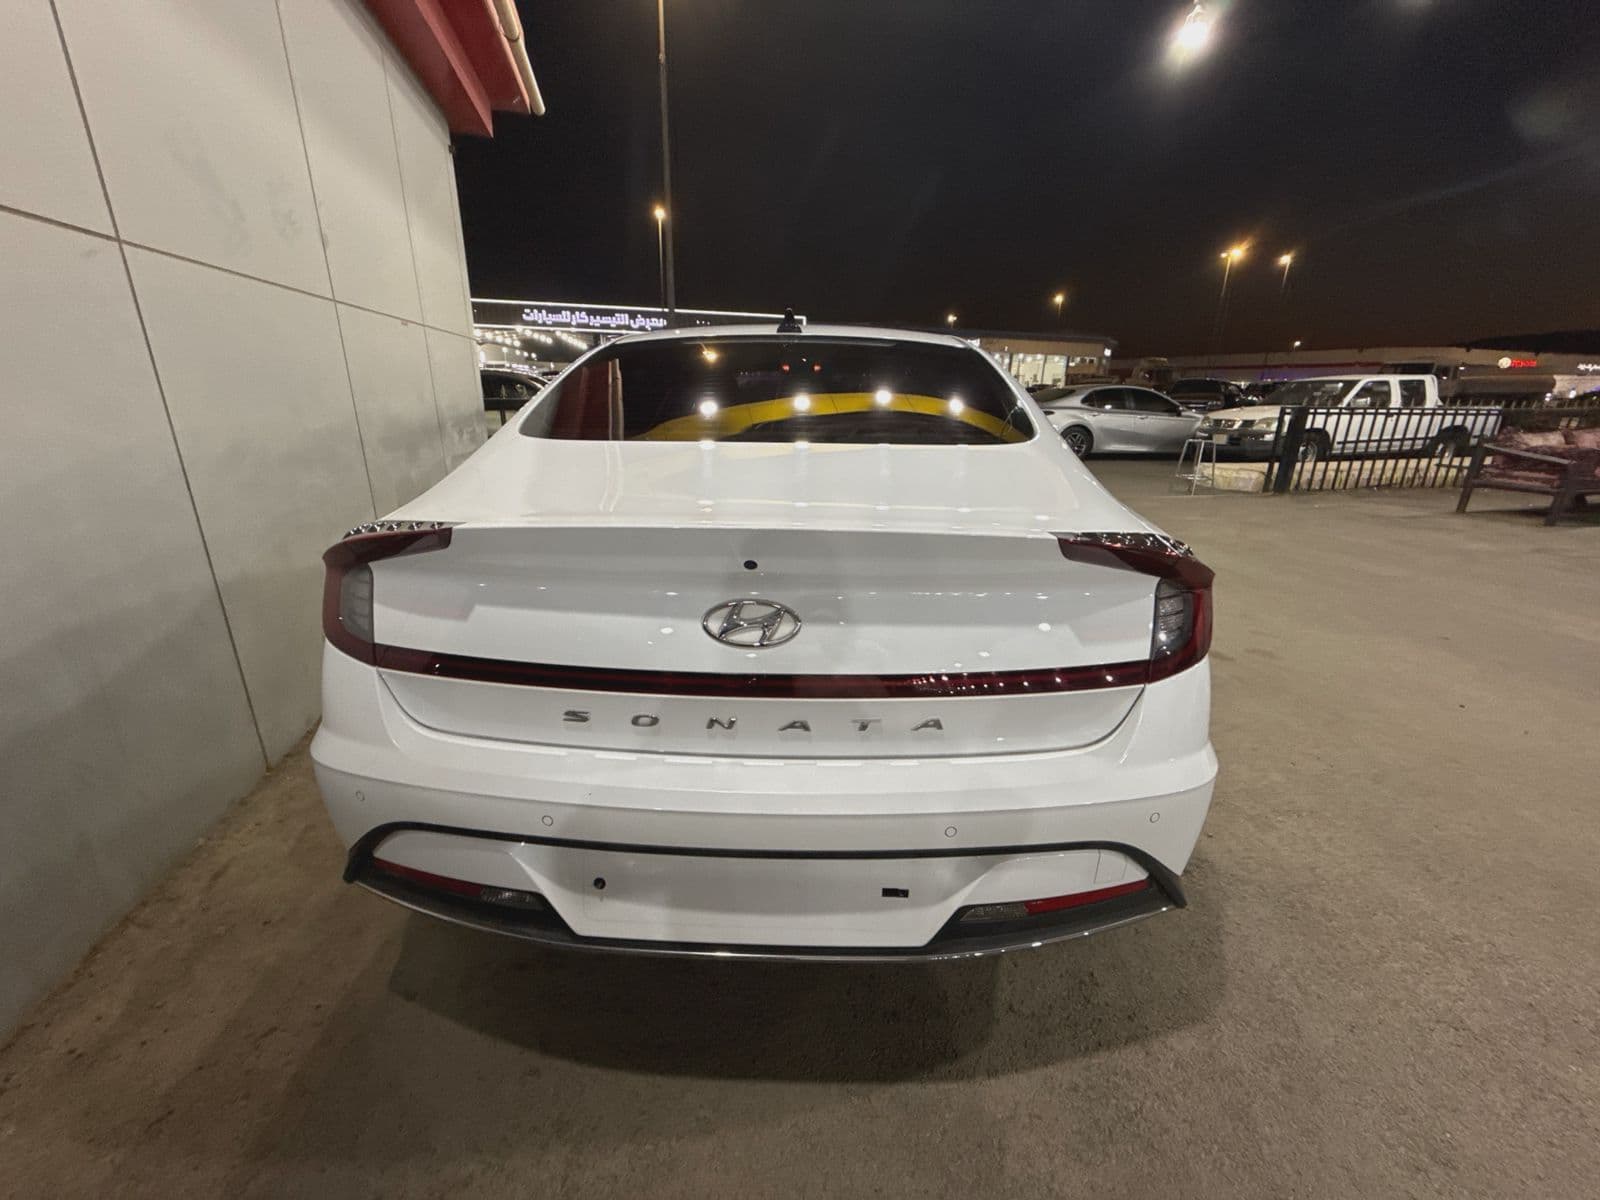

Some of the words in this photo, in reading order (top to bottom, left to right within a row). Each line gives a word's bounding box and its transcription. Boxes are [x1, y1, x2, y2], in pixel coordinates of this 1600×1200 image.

[522, 308, 570, 324] للسيارات
[571, 311, 589, 325] كار
[563, 710, 944, 732] SONATA
